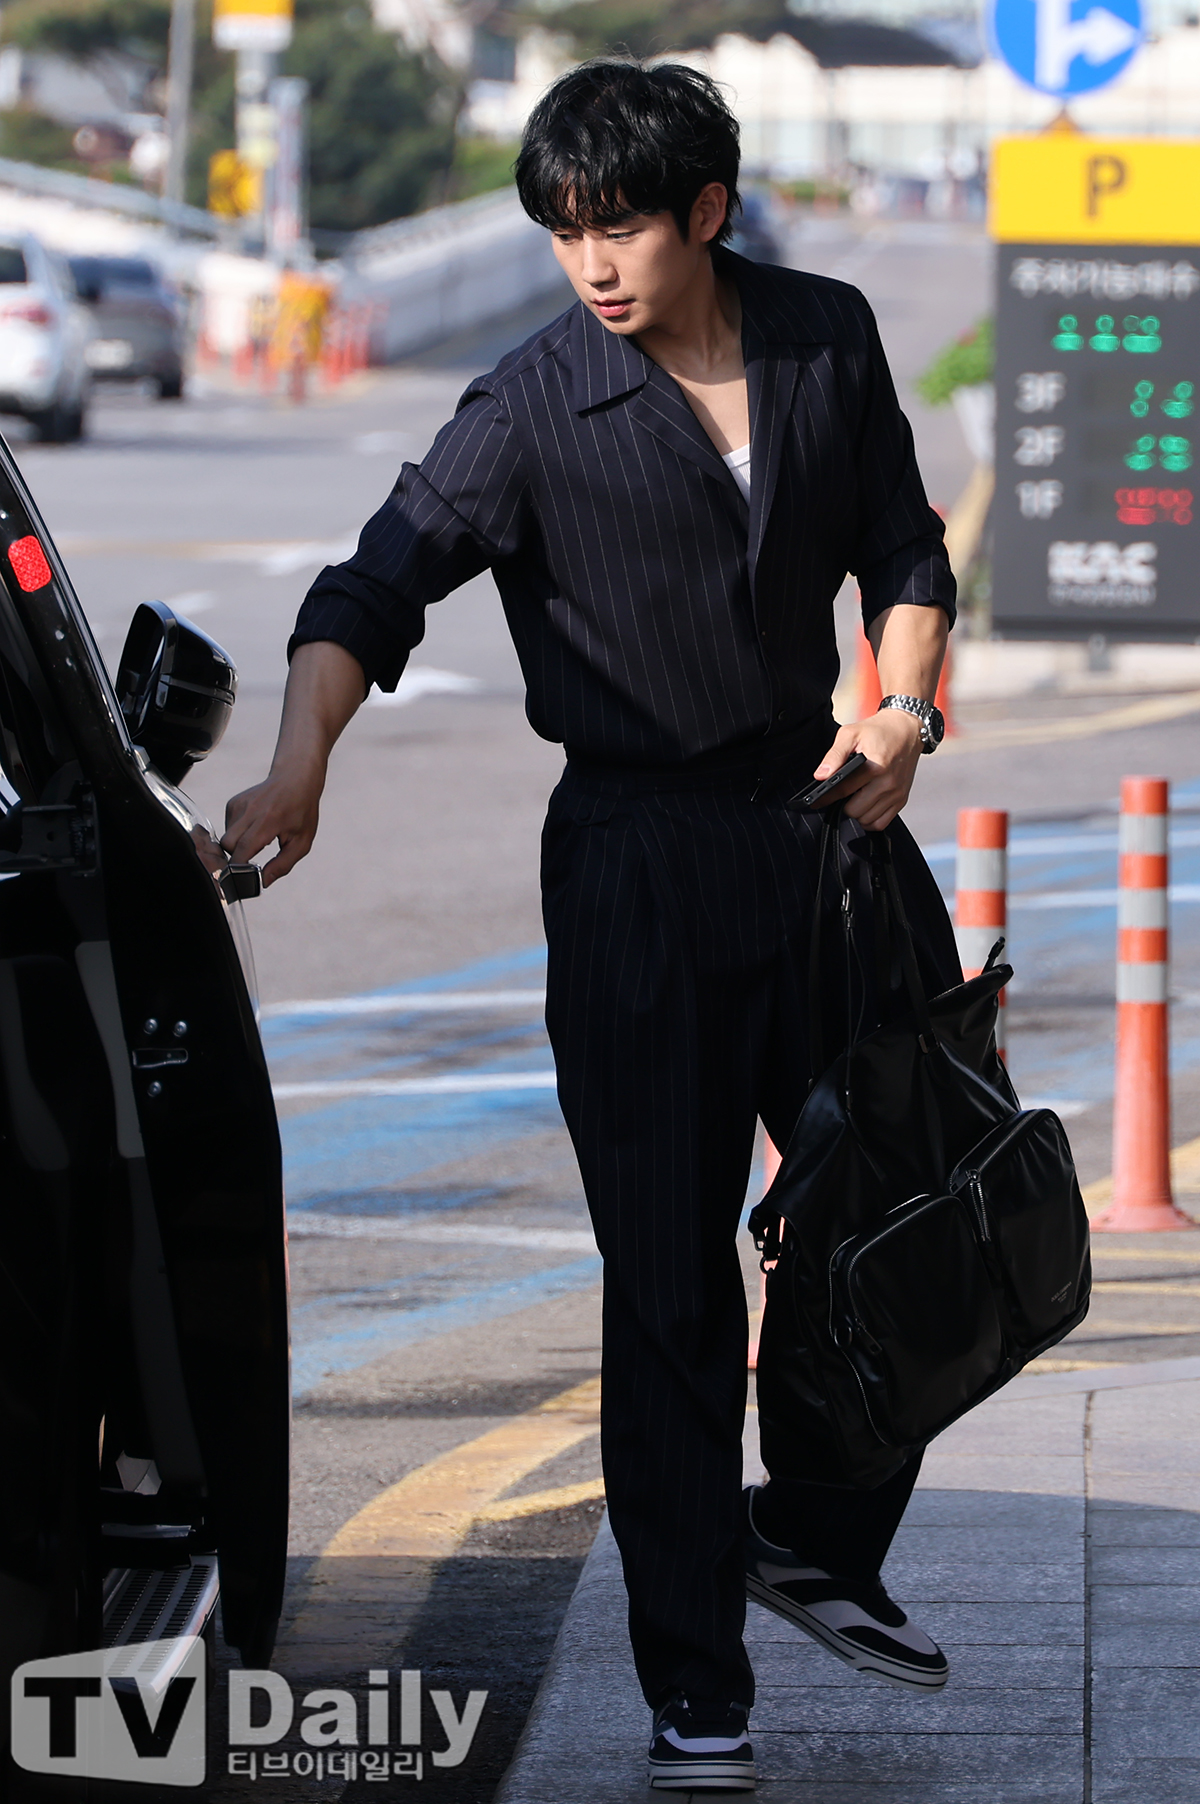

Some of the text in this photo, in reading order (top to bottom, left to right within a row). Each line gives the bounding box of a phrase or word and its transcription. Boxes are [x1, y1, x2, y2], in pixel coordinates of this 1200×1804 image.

[1087, 154, 1127, 218] P
[1015, 372, 1066, 413] 3F
[1014, 425, 1064, 466] 2F
[1016, 479, 1063, 519] 1F
[1048, 541, 1157, 584] KAC
